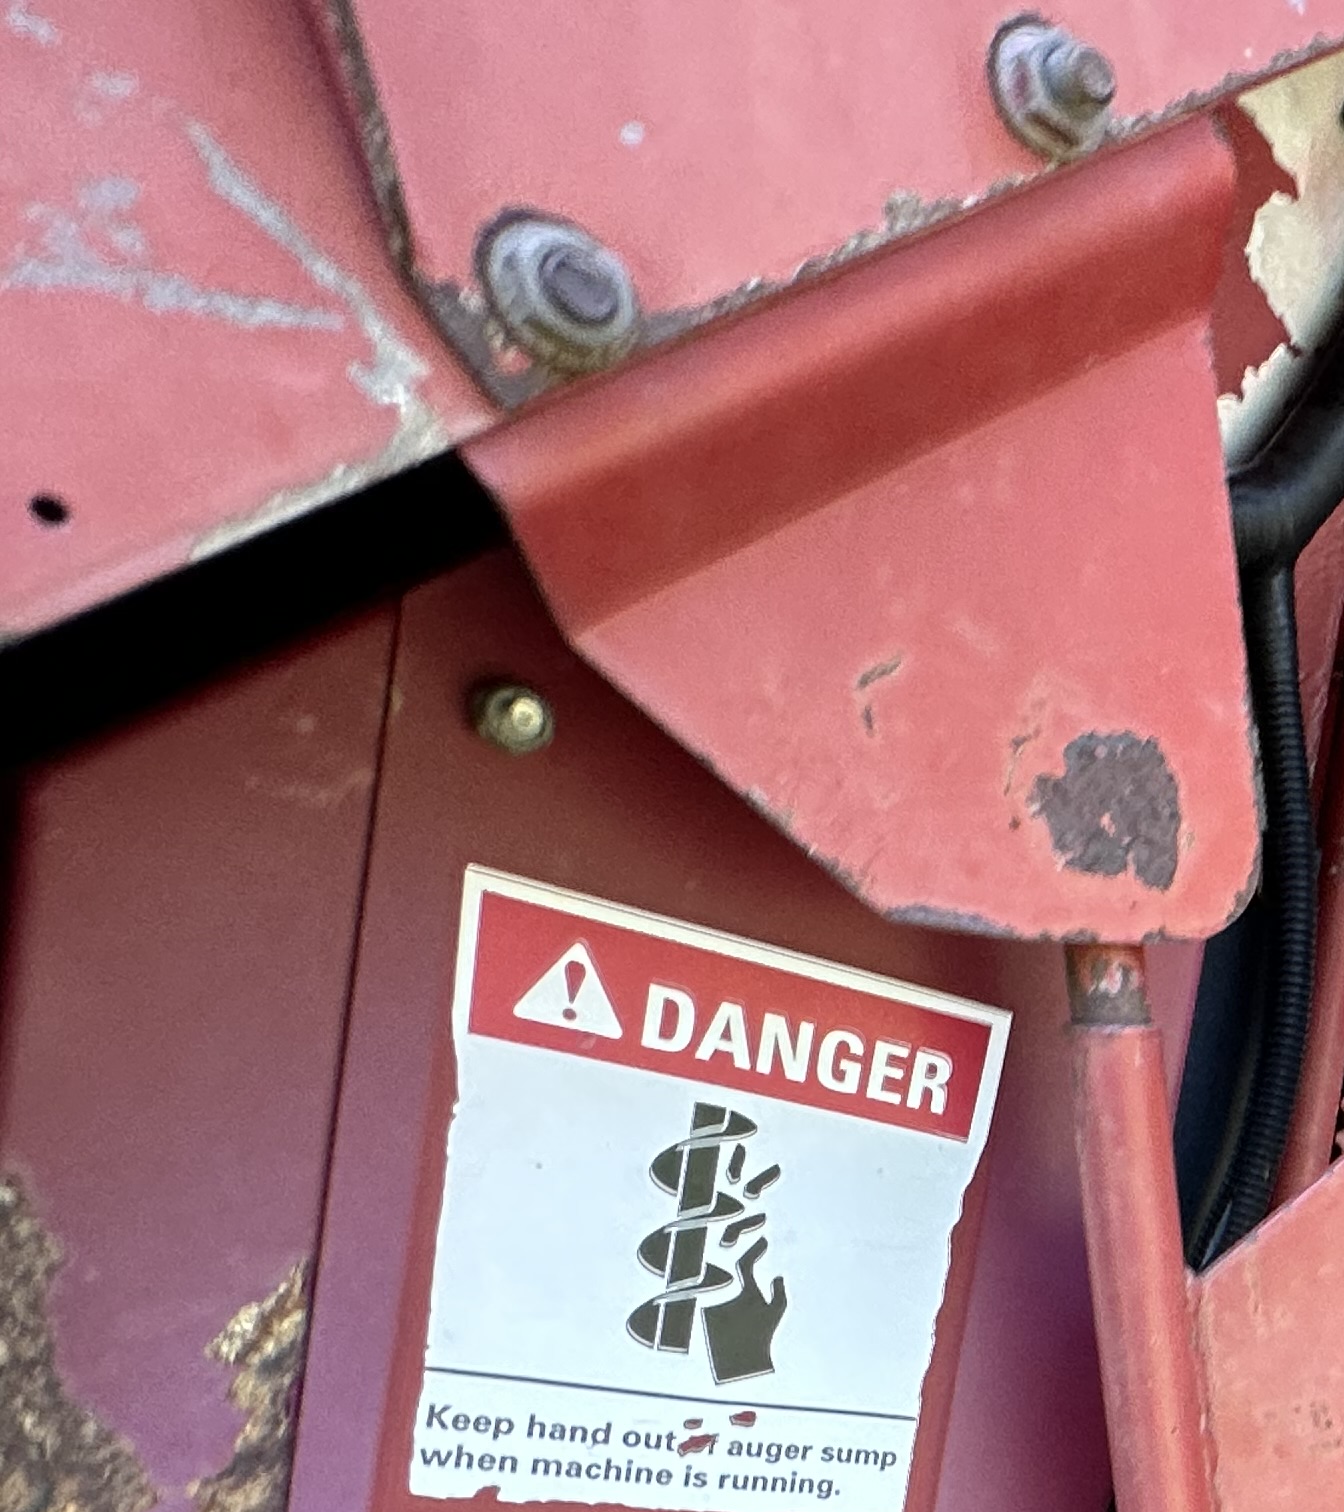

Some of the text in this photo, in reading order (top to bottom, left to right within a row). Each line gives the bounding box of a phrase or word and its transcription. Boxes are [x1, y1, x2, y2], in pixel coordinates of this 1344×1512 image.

[641, 982, 953, 1115] DANGER
[420, 1444, 841, 1500] when machine is running.
[426, 1403, 515, 1440] Keep
[527, 1413, 612, 1445] hand
[622, 1429, 677, 1451] out
[727, 1439, 813, 1464] auger
[820, 1445, 898, 1472] sump
